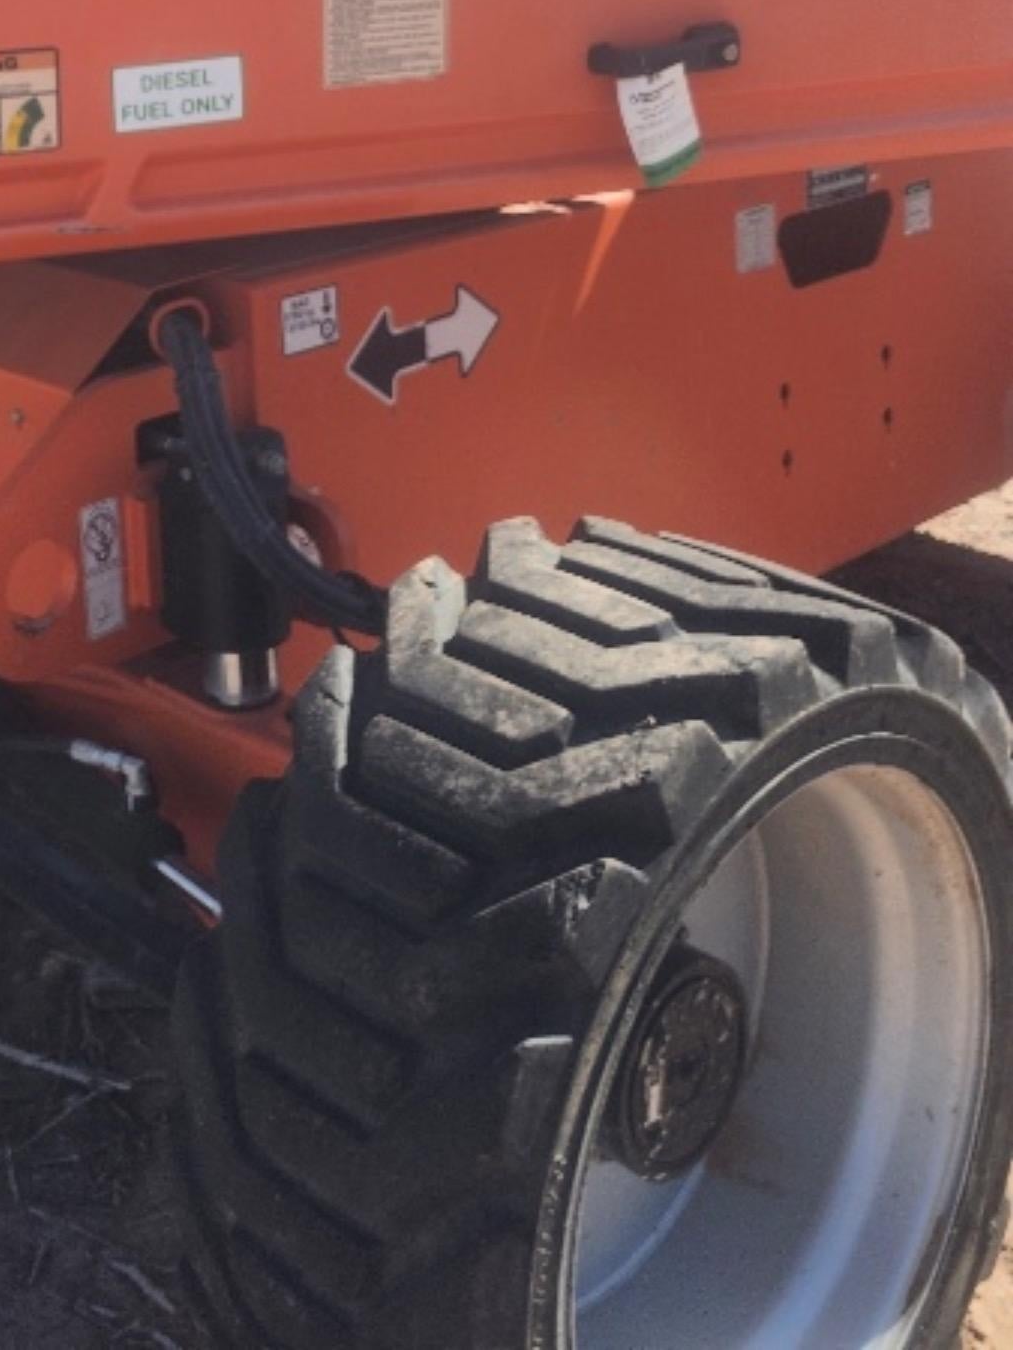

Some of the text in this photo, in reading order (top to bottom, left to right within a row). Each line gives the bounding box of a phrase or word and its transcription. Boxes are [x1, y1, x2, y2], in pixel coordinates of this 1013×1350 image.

[139, 68, 214, 94] DIESEL
[120, 92, 235, 123] FUEL ONLY
